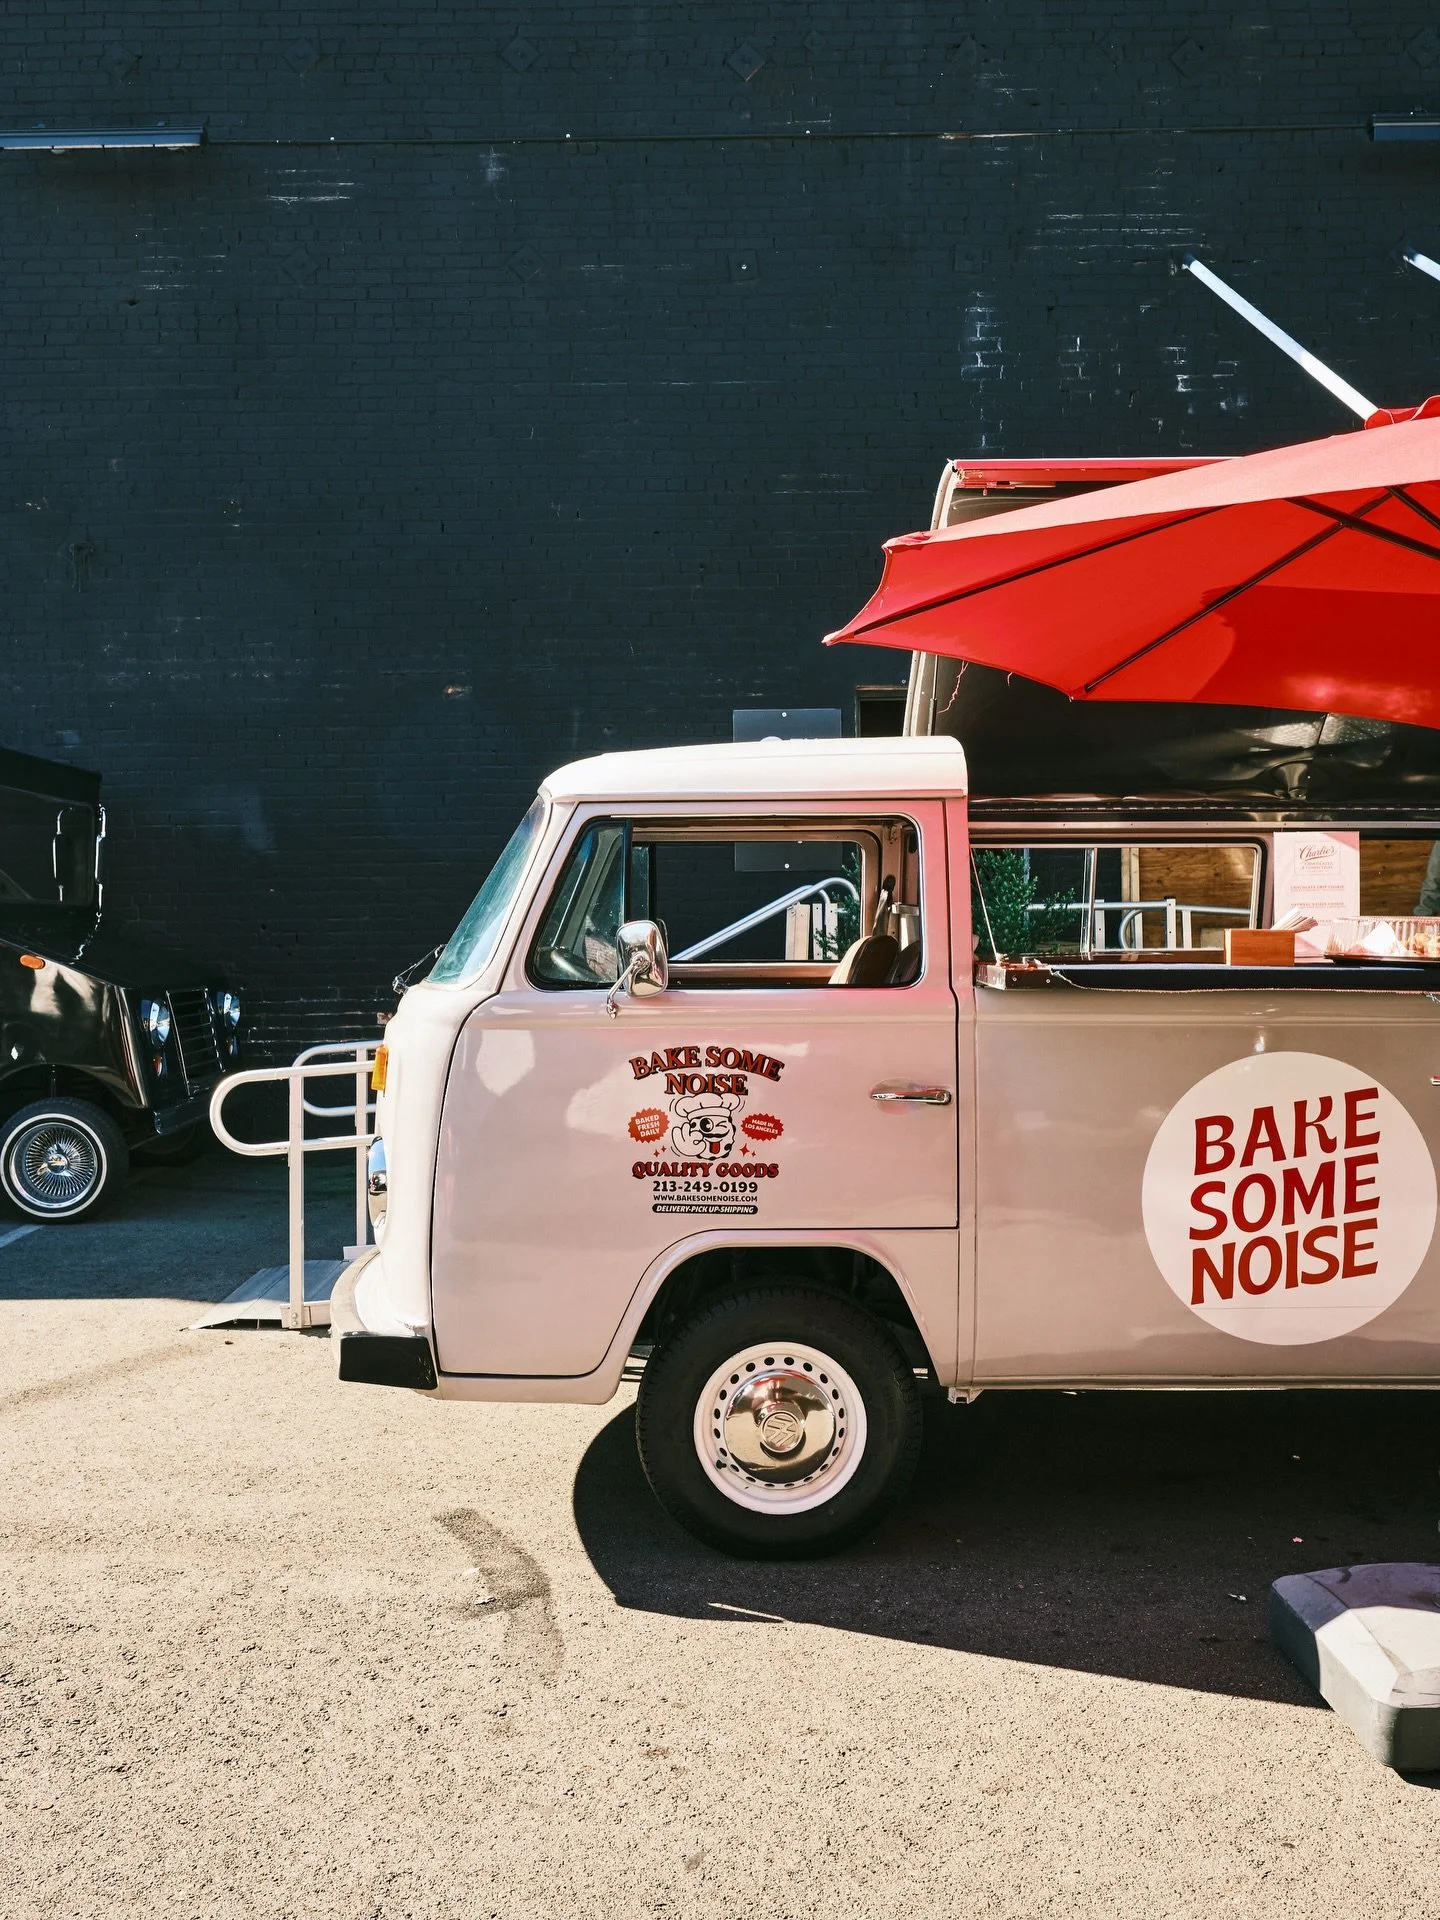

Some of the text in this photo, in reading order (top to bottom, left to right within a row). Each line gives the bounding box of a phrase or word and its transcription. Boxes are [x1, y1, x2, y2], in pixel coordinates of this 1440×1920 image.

[629, 1045, 785, 1082] BAKE SOME
[664, 1073, 749, 1096] NOISE
[635, 1114, 659, 1125] BAKED
[637, 1121, 660, 1131] FRESH
[640, 1127, 660, 1137] DAILY
[755, 1125, 779, 1134] ANGELES
[1194, 1087, 1381, 1176] BAKE
[632, 1161, 779, 1179] QUALITY GOODS
[652, 1181, 758, 1193] 213-249-0199
[653, 1194, 758, 1202] WWW.BAKESOMENOISE.COM
[1189, 1152, 1381, 1241] SOME
[1191, 1217, 1379, 1306] NOISE
